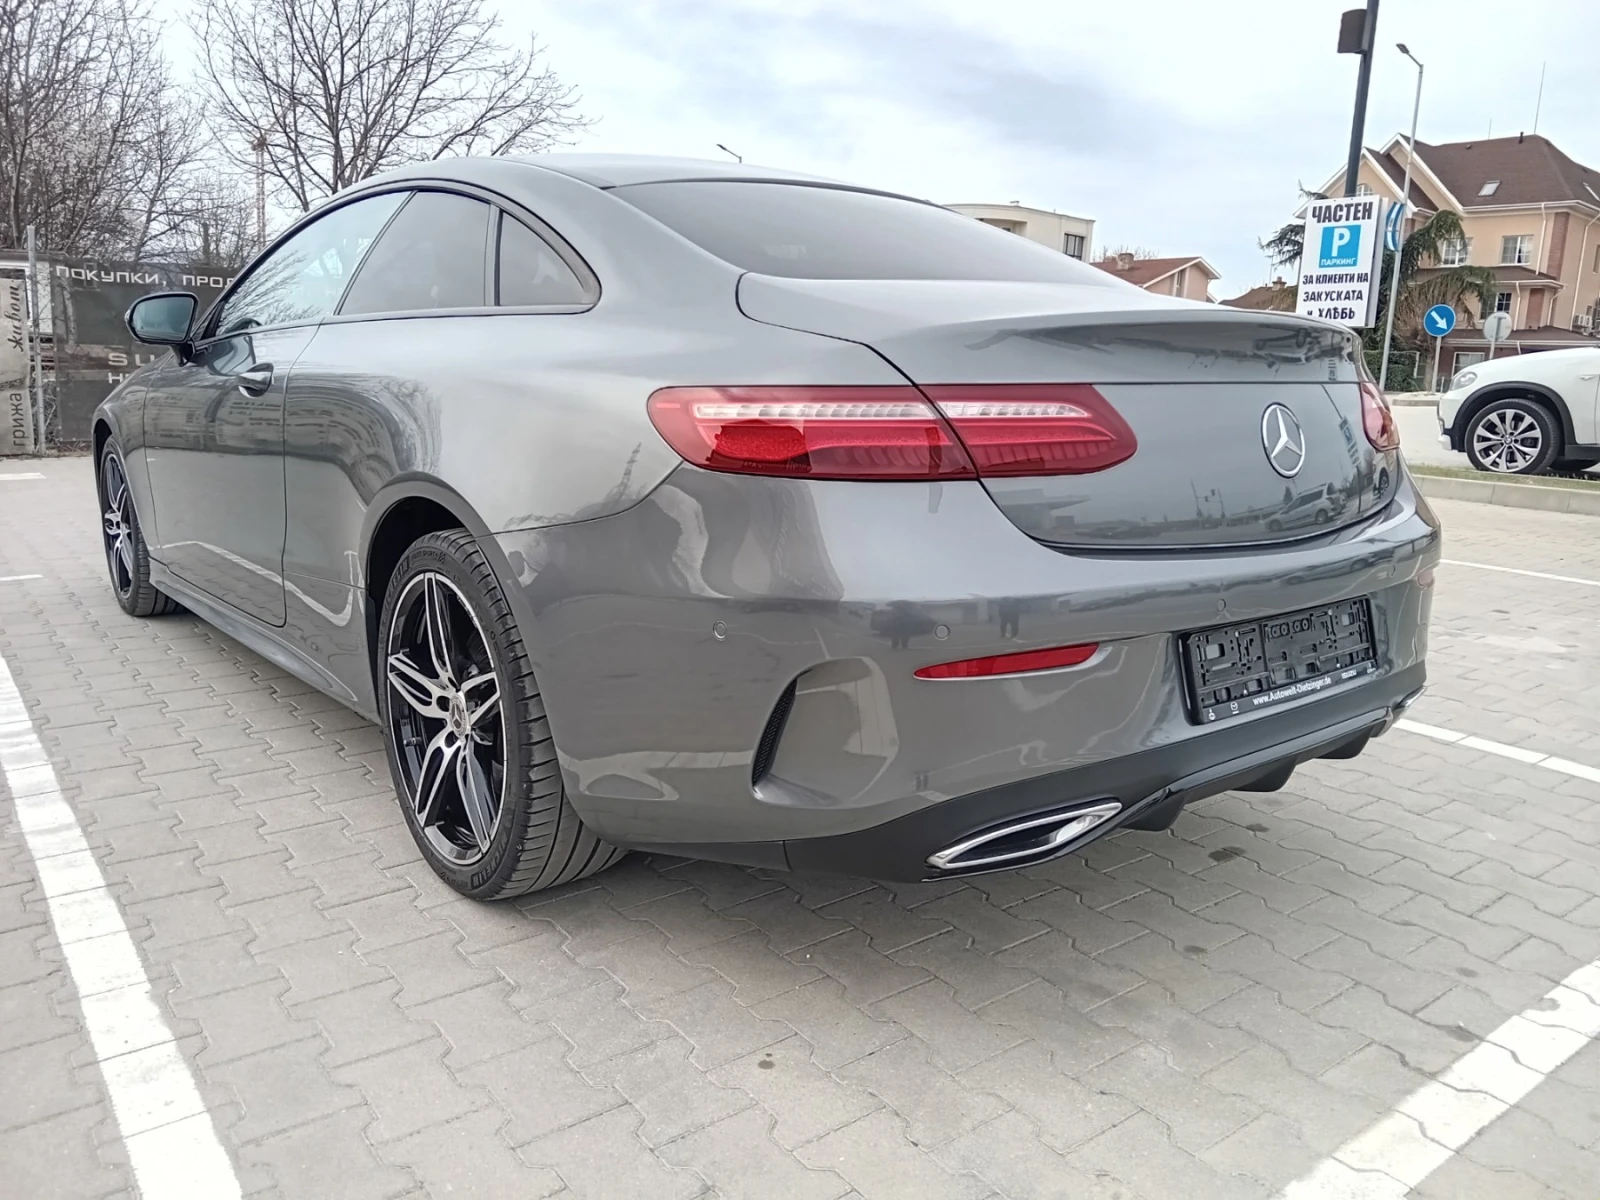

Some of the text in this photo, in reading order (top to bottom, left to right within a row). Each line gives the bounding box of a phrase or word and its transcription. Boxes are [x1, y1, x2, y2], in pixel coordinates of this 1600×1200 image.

[1312, 202, 1374, 223] ЧАСТЕН
[1320, 258, 1356, 267] ПАРКИНГ
[56, 265, 167, 287] ПОКУПКИ,
[1303, 272, 1369, 285] ЗА КЛИЕНТИ НА
[1303, 290, 1363, 302] ЗАКУСКАТА
[10, 393, 29, 447] грижа
[1252, 676, 1332, 706] www.Autowelt-Dietzinger.de
